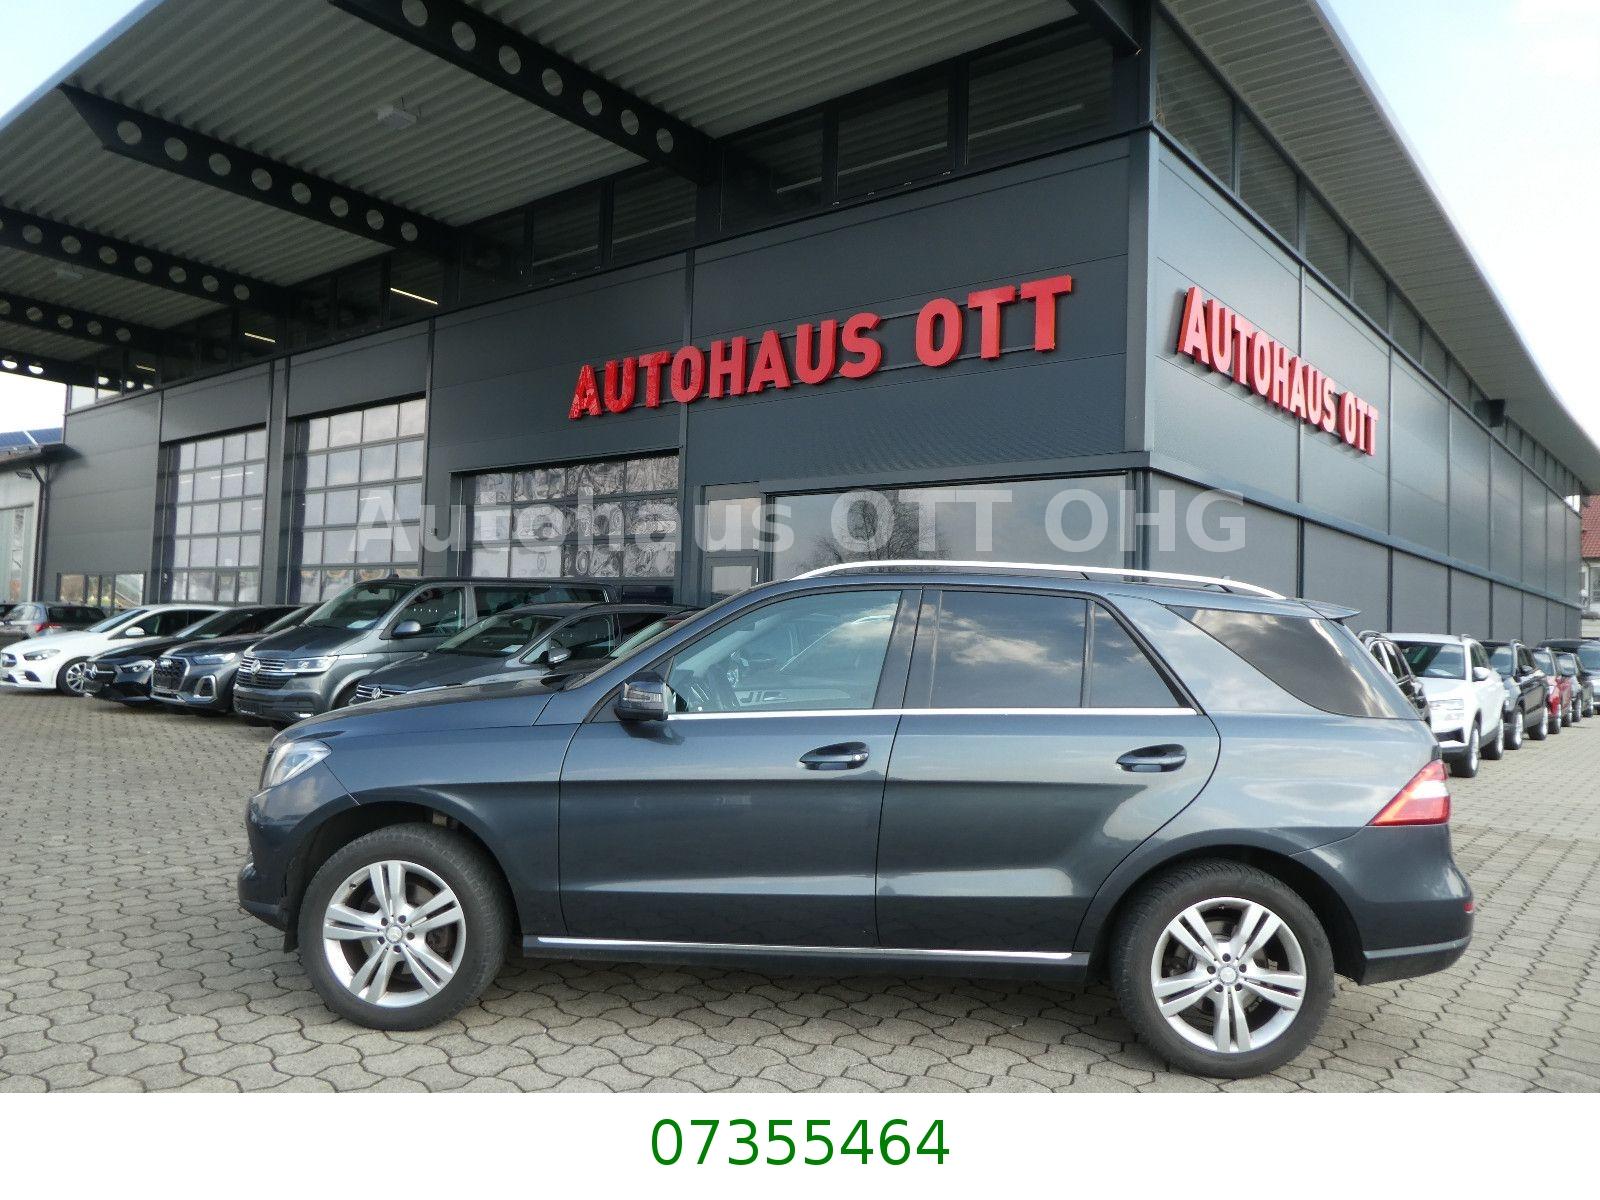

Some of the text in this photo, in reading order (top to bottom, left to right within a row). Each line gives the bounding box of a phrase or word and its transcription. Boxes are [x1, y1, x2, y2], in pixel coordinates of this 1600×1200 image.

[569, 275, 1073, 420] AUTOHAUS OTT
[1178, 286, 1379, 455] AUTOHAUS OTT
